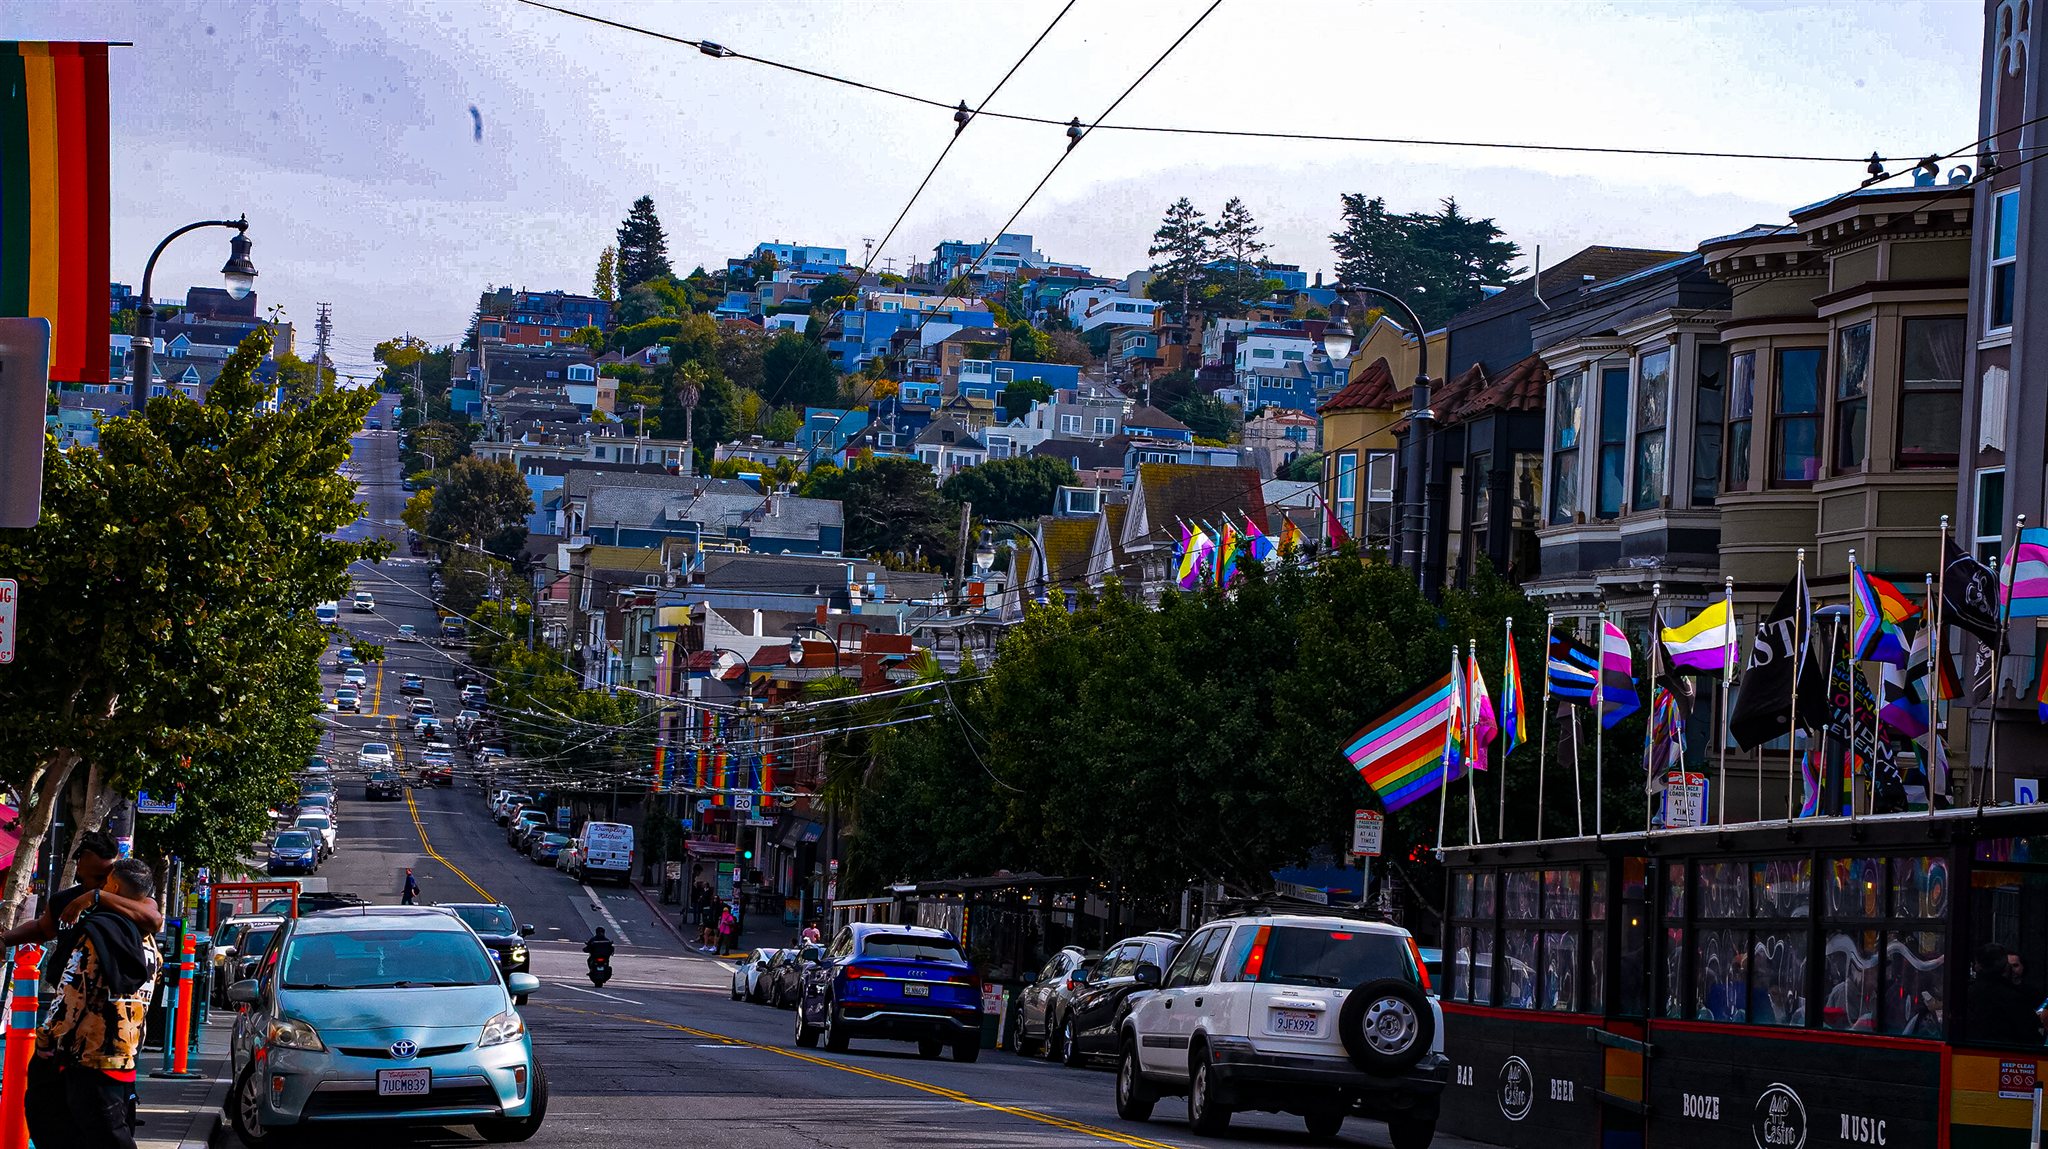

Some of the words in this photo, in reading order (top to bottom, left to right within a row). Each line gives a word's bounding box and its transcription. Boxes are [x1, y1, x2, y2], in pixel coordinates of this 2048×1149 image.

[736, 800, 750, 808] 20
[1277, 1018, 1315, 1032] 9JFX992
[382, 1079, 426, 1092] 7UCM839
[1457, 1065, 1473, 1086] BAR
[1551, 1078, 1574, 1102] BEER
[1683, 1093, 1720, 1121] BOOZE
[1763, 1117, 1796, 1146] Castro
[1840, 1113, 1886, 1146] MUSIC
